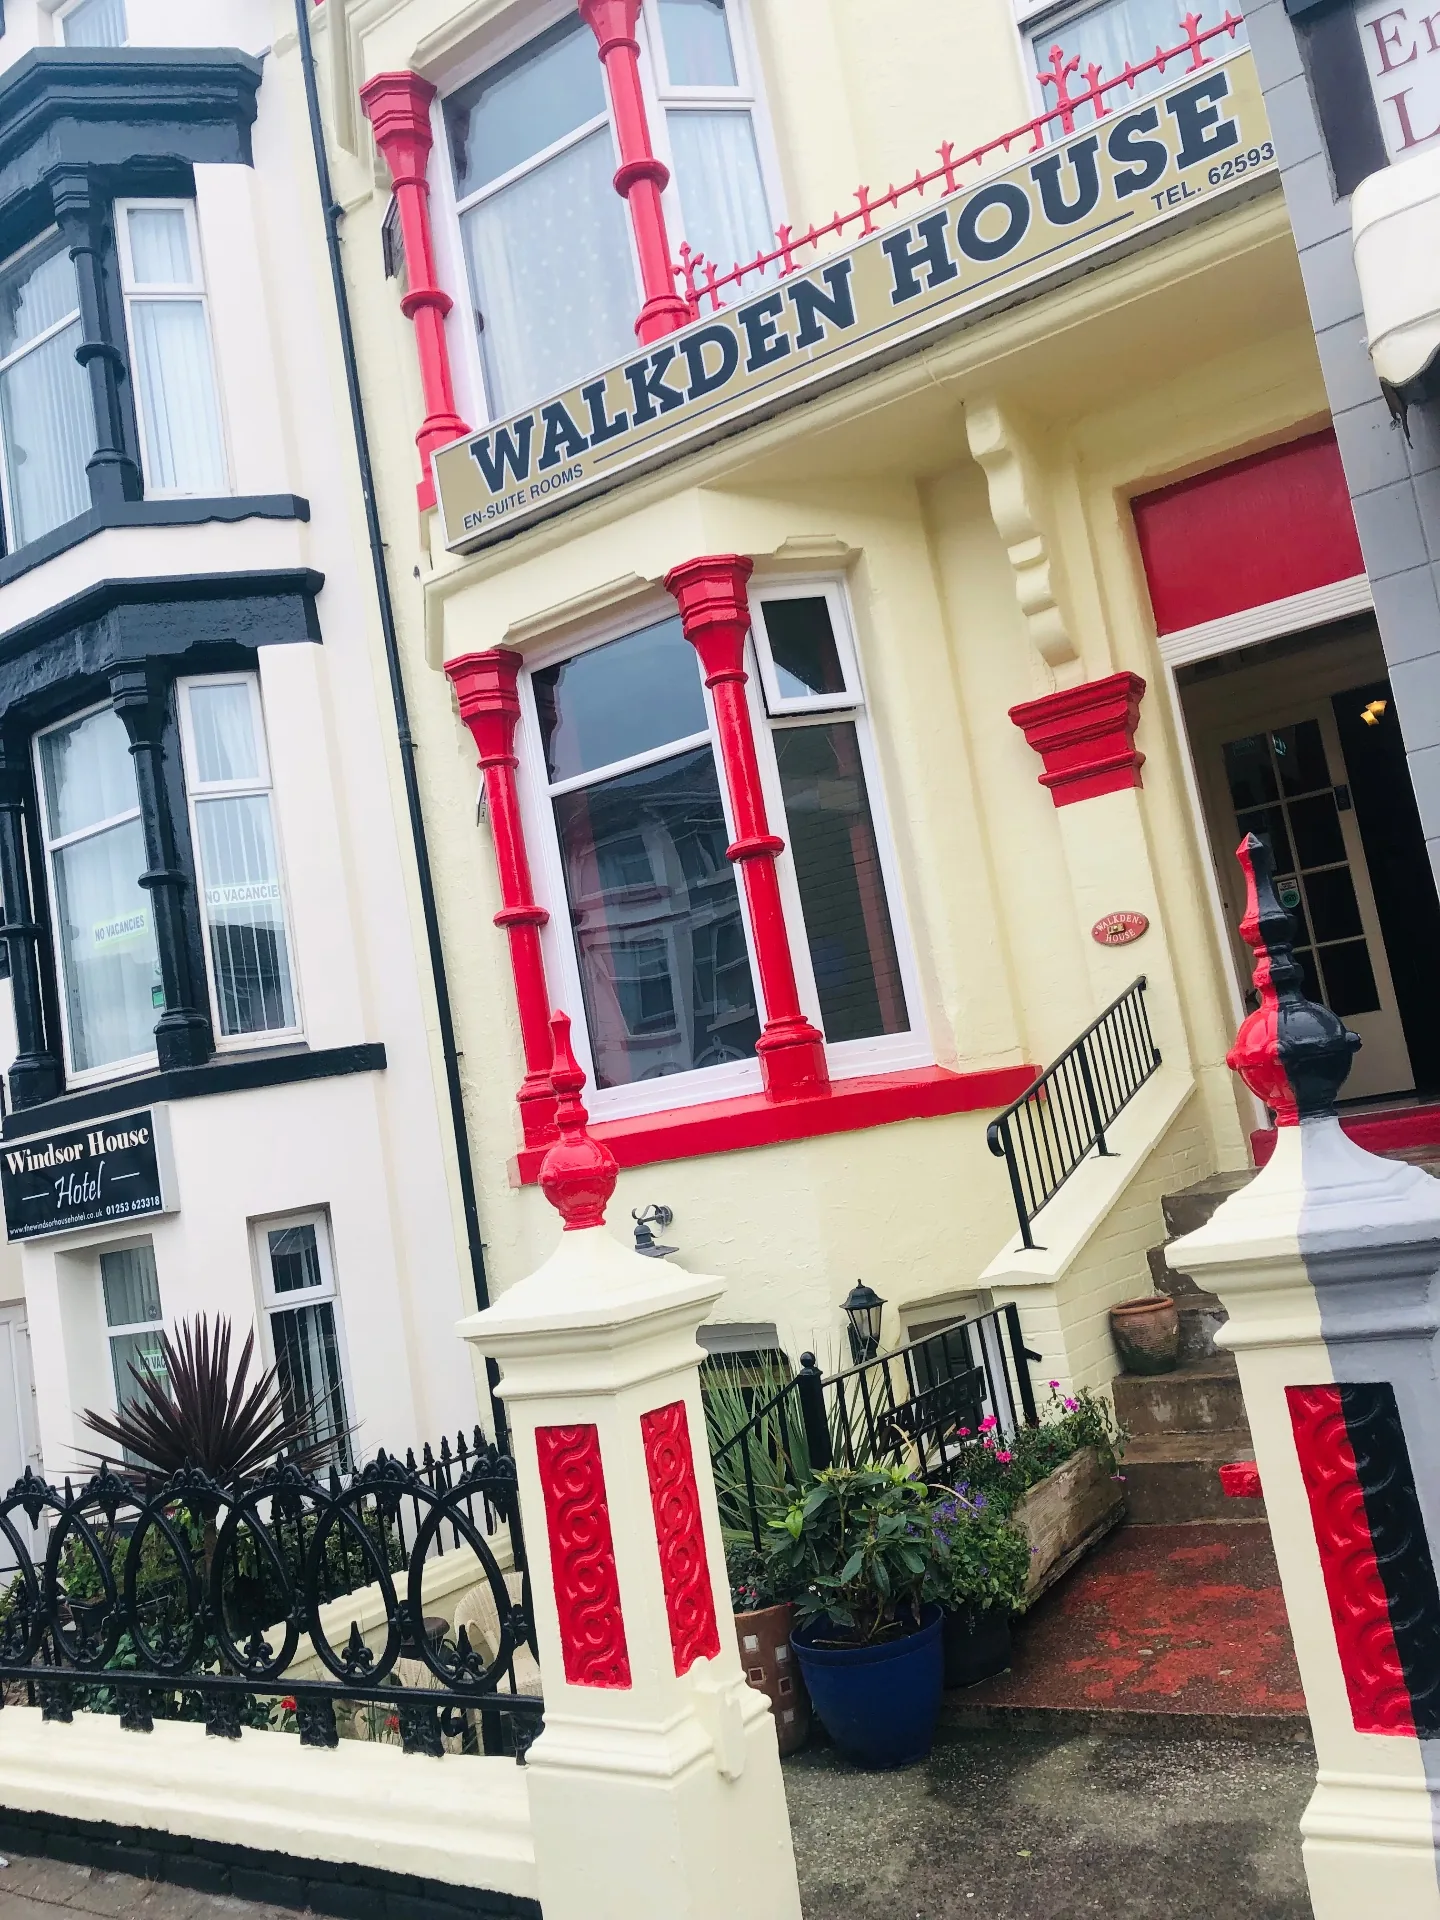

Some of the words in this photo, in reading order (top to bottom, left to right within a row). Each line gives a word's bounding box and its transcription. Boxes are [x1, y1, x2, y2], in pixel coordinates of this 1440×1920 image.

[1151, 181, 1202, 211] TEL.
[1208, 142, 1275, 186] 62593
[470, 256, 857, 494] WALKDEN
[882, 71, 1240, 305] HOUSE
[463, 490, 527, 531] EN-SUITE
[530, 463, 583, 499] ROOMS
[205, 889, 221, 904] NO
[223, 884, 280, 902] VACANCIE
[95, 926, 107, 942] NO
[107, 914, 145, 938] VACANCIES
[1096, 914, 1140, 932] WALKDEN
[1106, 928, 1136, 942] HOUSE
[5, 1143, 84, 1176] Windsor
[87, 1126, 150, 1158] House
[54, 1160, 106, 1209] Hotel
[9, 1208, 103, 1236] www.thewindsorhousehotel.co.uk
[105, 1202, 130, 1216] 01253
[131, 1195, 160, 1211] 623318
